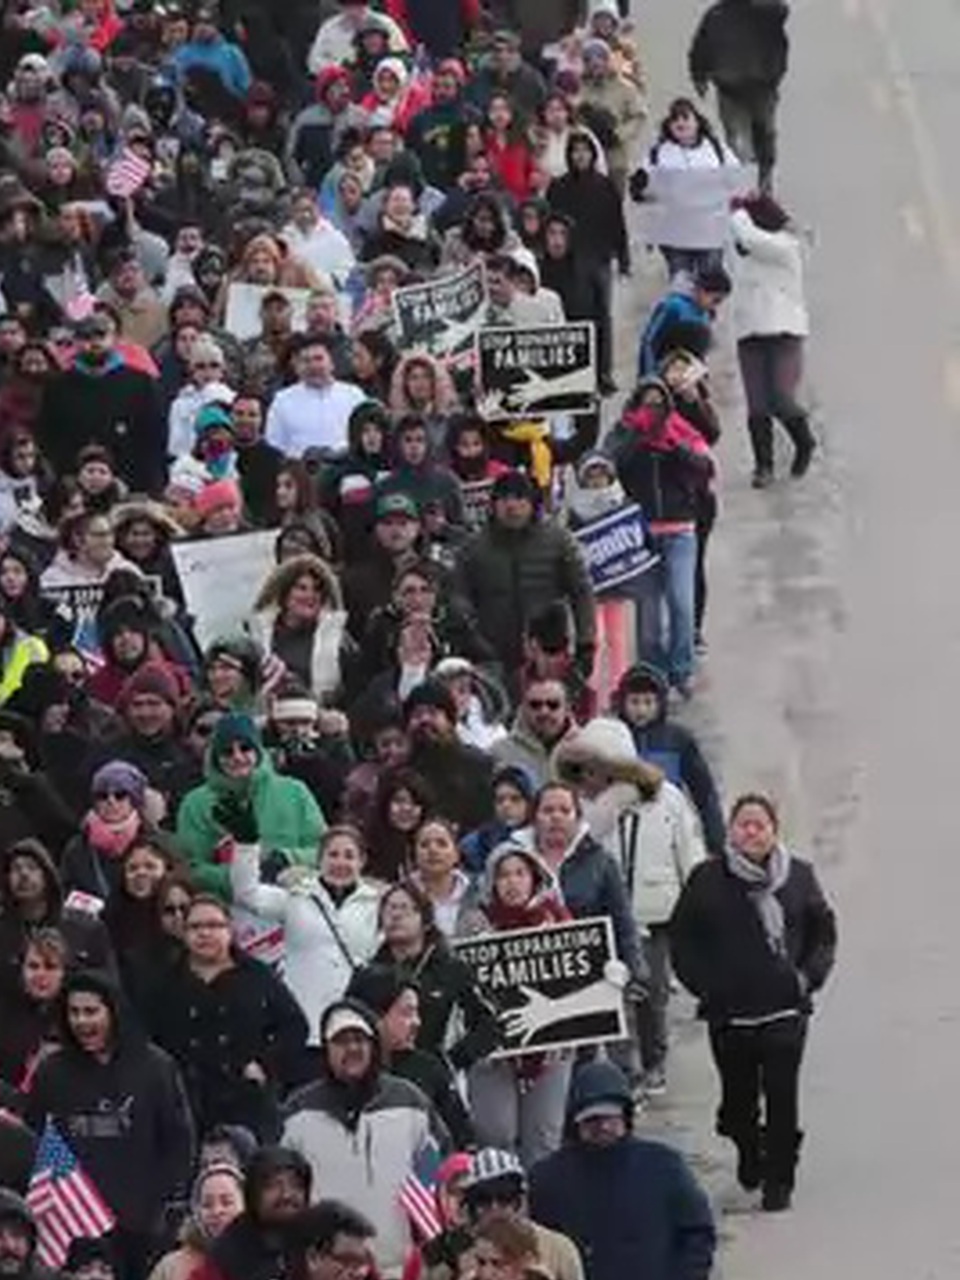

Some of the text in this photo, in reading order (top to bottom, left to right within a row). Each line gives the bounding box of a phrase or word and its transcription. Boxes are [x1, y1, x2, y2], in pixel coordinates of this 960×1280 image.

[494, 345, 577, 370] FAMILIES
[503, 926, 602, 959] SEPARATING
[477, 950, 592, 989] FAMILIES
